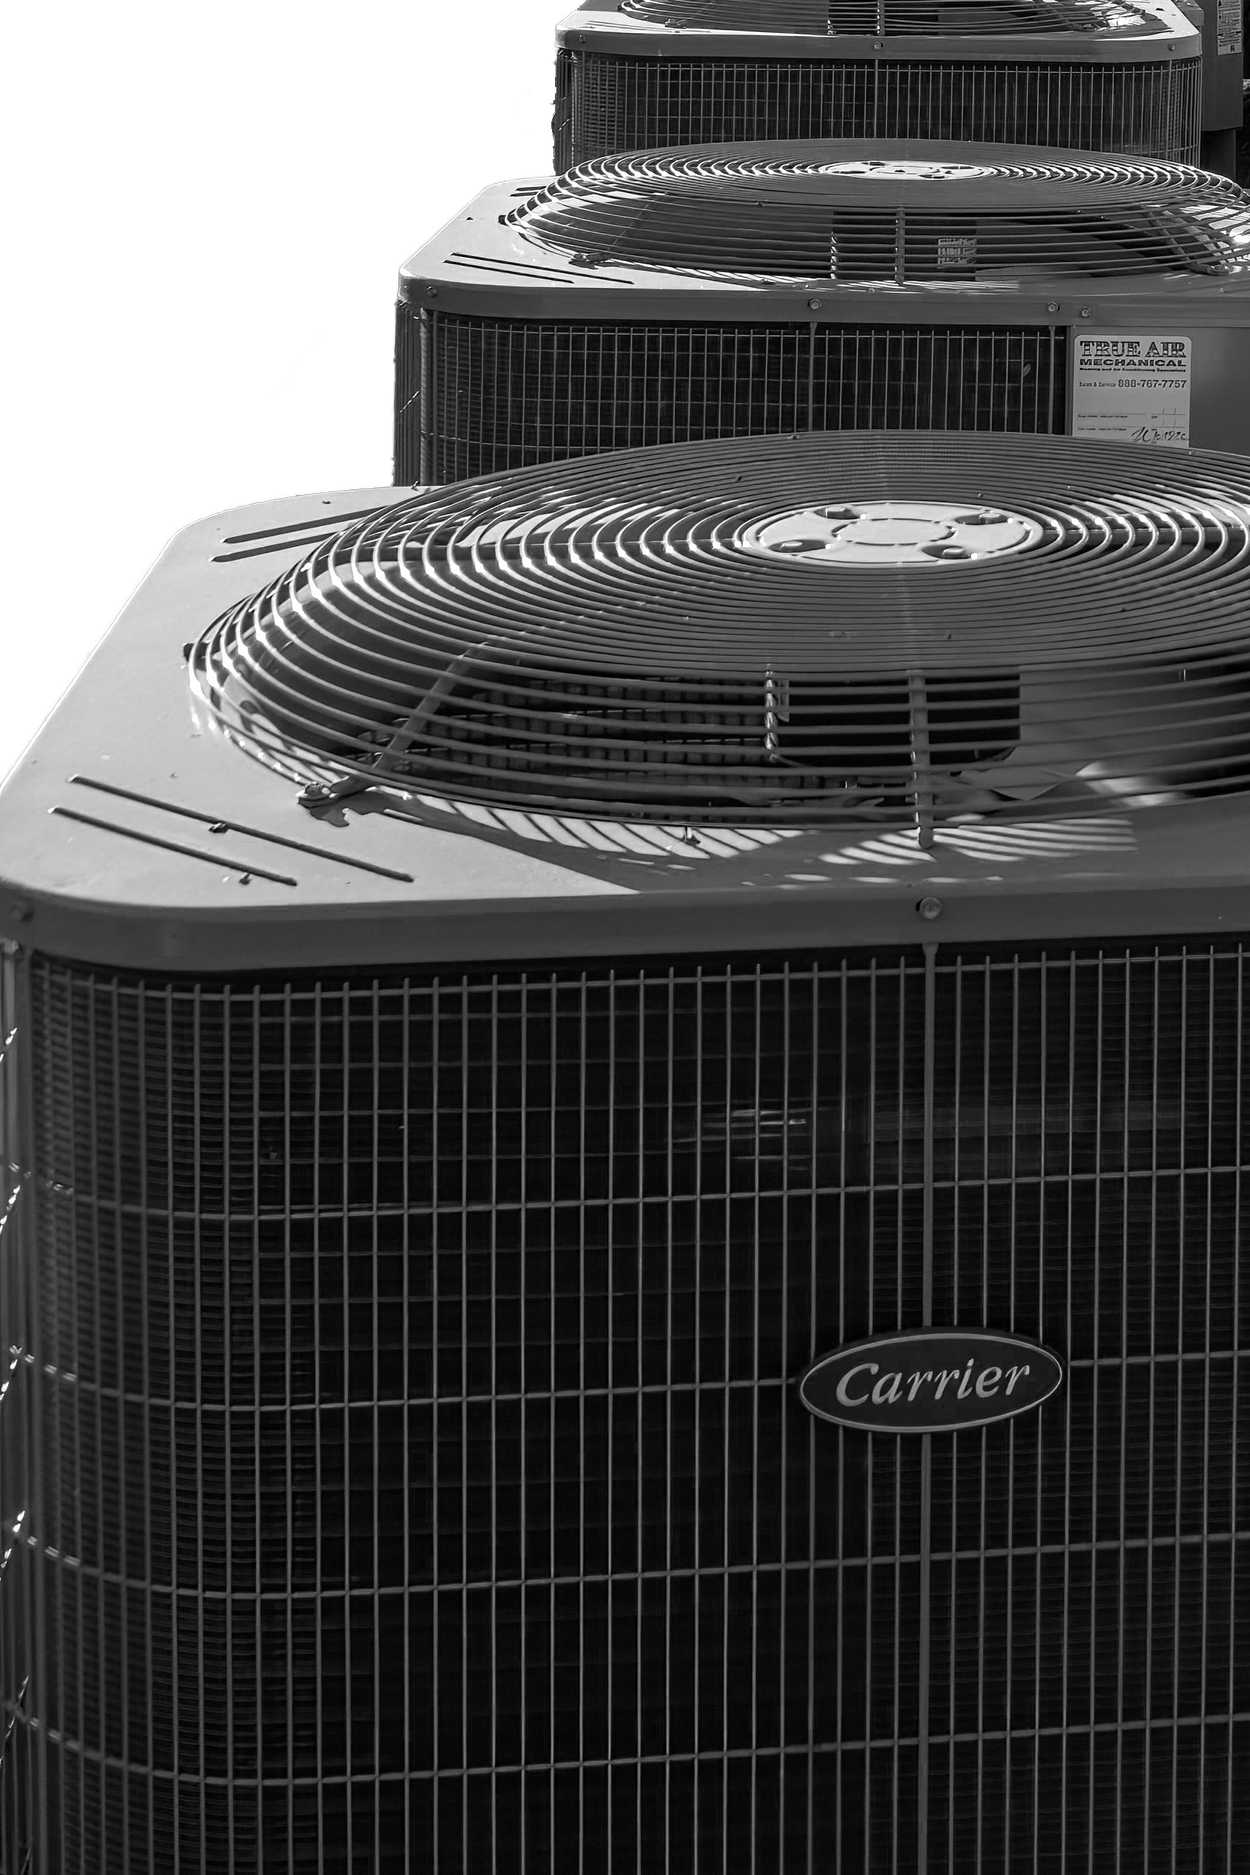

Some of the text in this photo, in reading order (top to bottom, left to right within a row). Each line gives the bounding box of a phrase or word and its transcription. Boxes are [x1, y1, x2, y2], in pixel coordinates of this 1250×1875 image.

[1080, 340, 1187, 358] TRUE AIR
[1079, 358, 1187, 367] MECHANICAL
[835, 1358, 1030, 1407] Carrier
